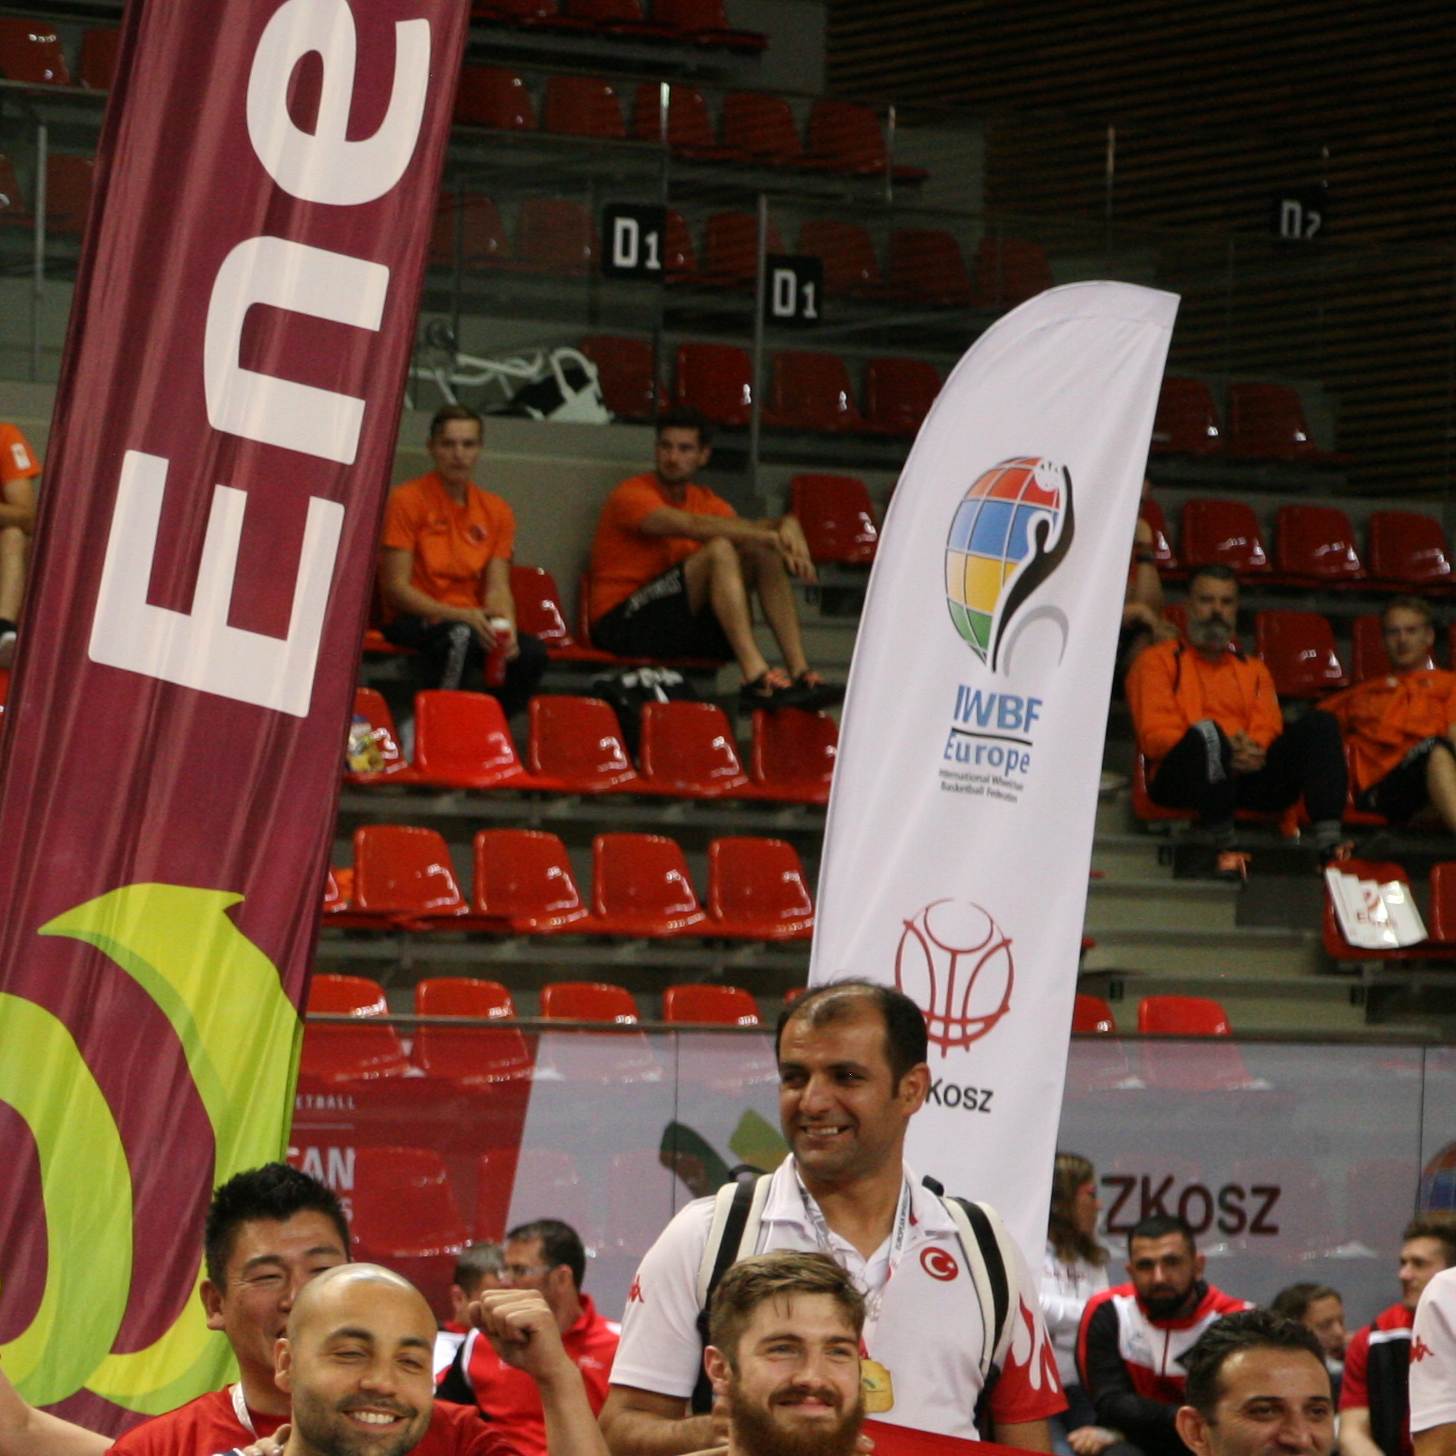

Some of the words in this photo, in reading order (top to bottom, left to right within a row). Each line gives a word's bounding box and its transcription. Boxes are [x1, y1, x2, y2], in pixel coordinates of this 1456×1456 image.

[613, 216, 662, 270] D1
[772, 268, 818, 319] D1
[953, 684, 1044, 733] IWBF
[943, 731, 1031, 778] Europe
[926, 1077, 994, 1113] Kosz
[1099, 1173, 1282, 1237] ZKosz
